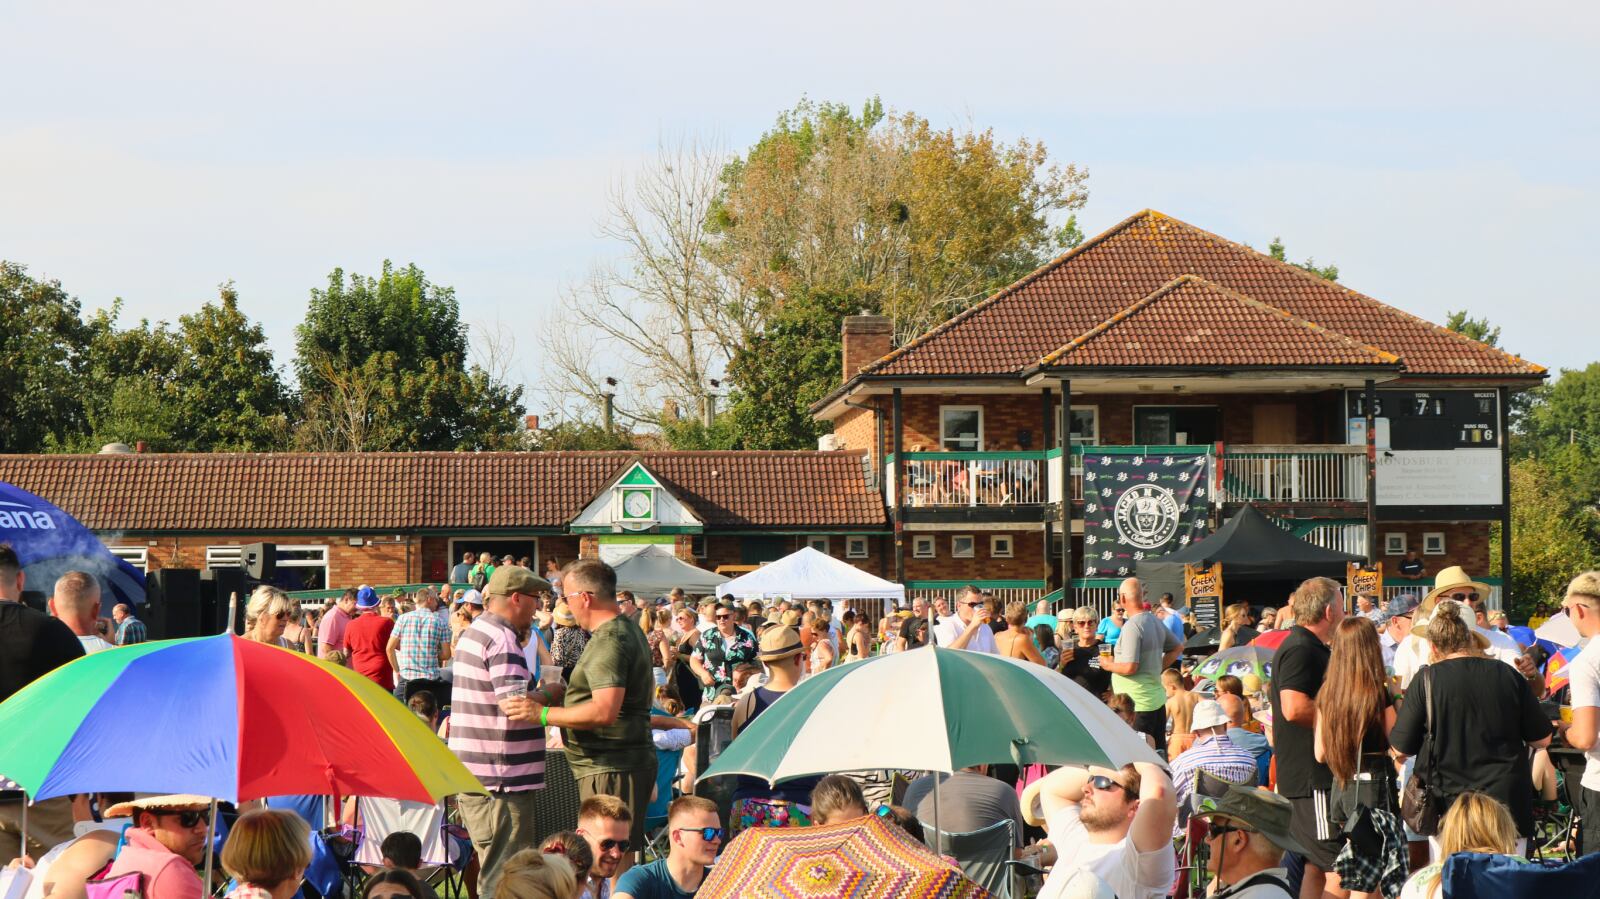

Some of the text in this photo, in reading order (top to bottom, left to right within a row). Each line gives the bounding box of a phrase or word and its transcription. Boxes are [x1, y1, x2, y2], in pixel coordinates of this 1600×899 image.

[1156, 493, 1176, 521] JUICY
[1191, 576, 1217, 587] CHEEKY
[1352, 575, 1378, 584] CHEEKY
[1193, 584, 1215, 595] CHIPS
[1354, 584, 1376, 593] CHIPS
